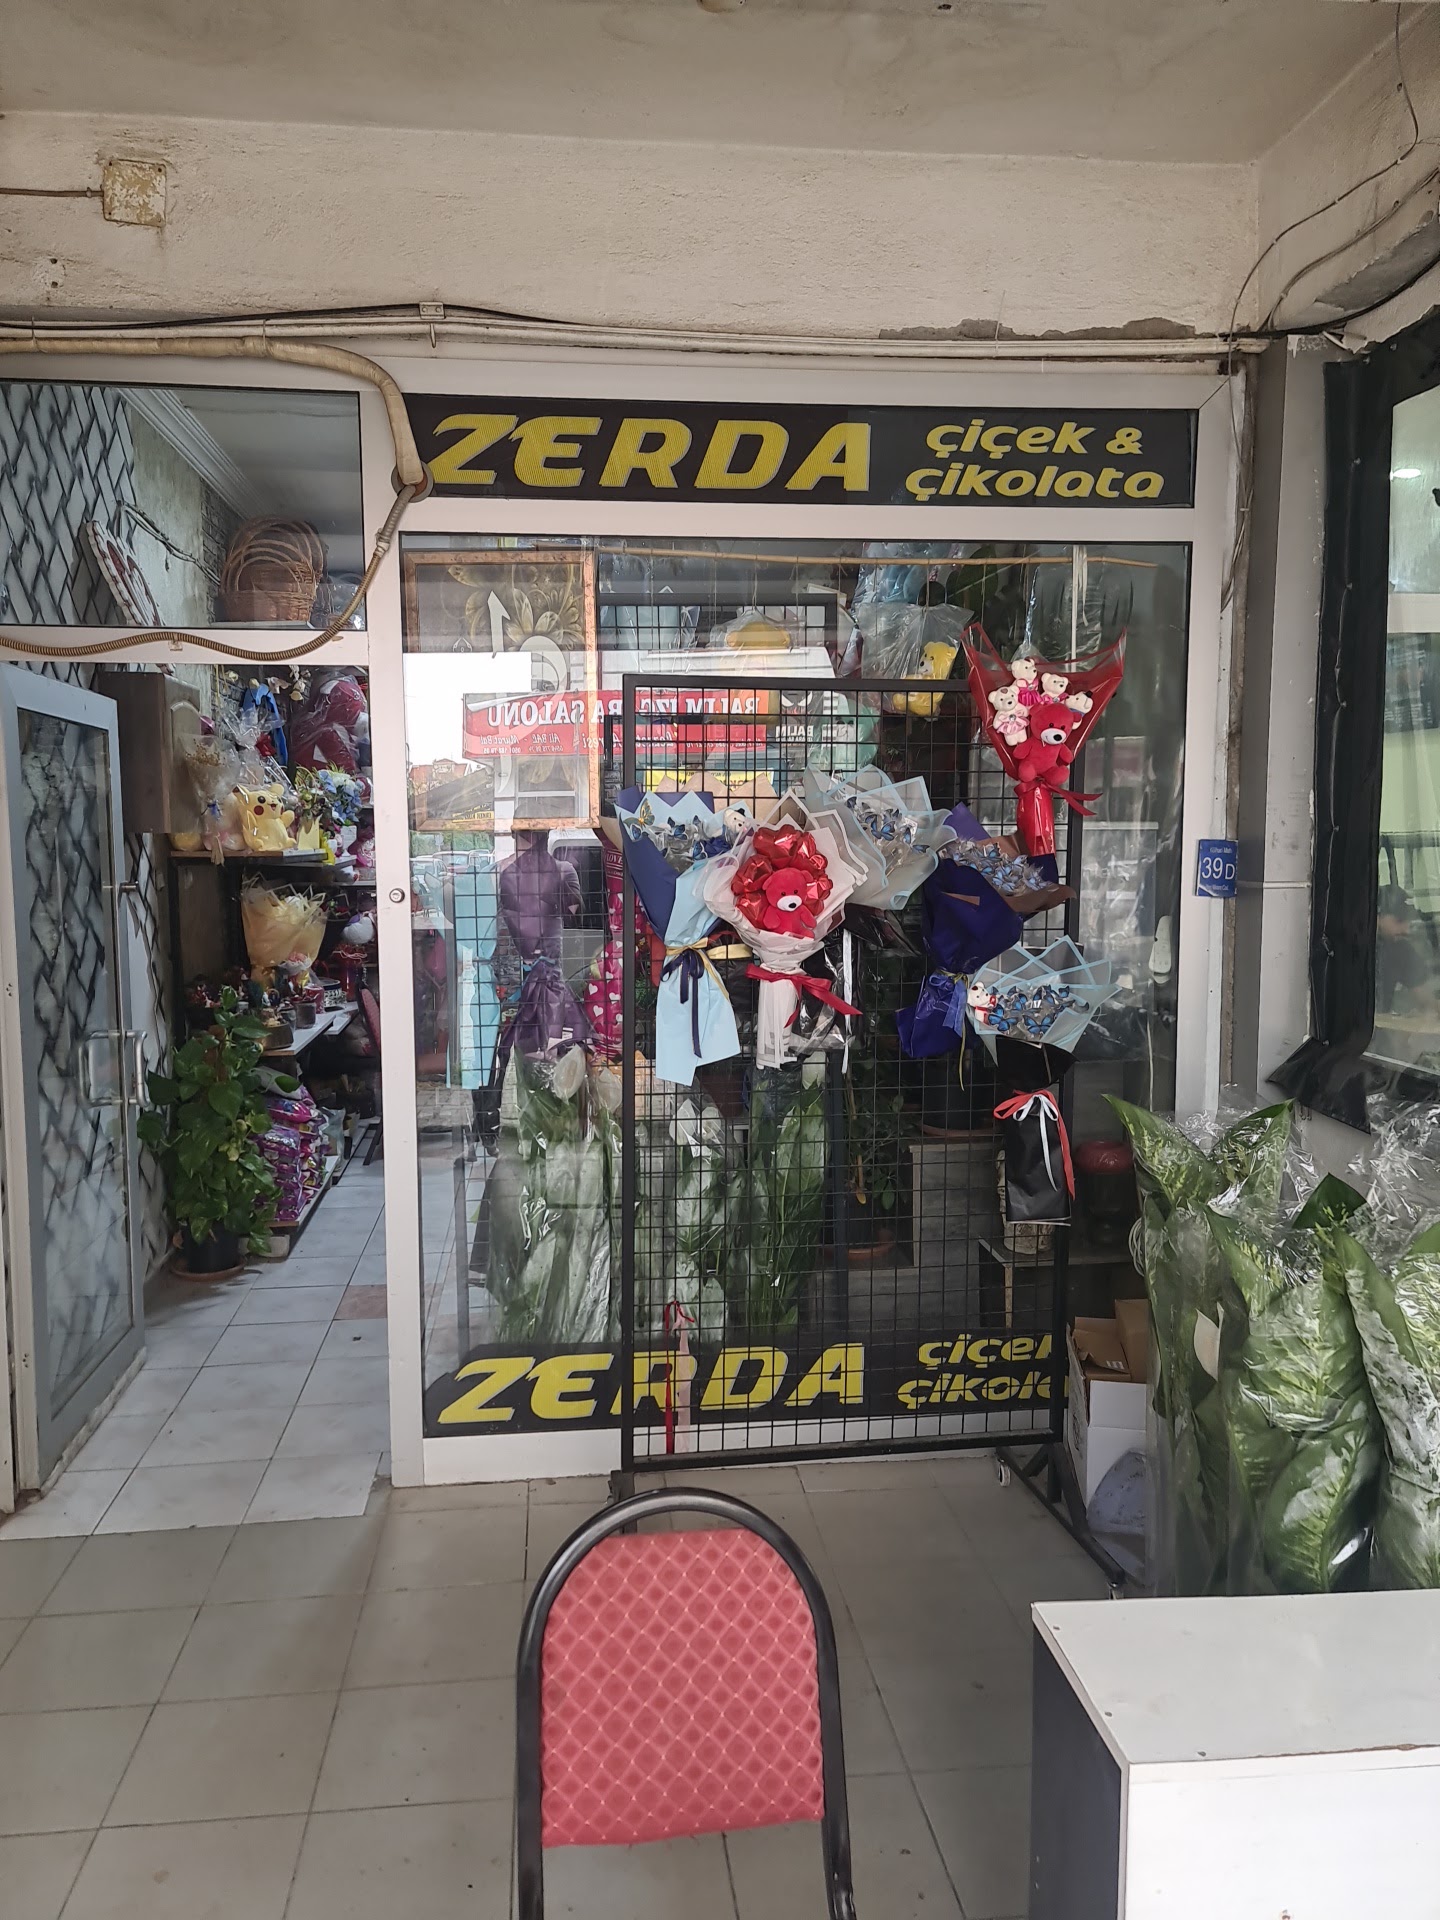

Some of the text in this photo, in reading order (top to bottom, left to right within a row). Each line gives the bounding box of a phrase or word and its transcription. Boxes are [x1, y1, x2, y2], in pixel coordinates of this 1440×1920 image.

[428, 413, 871, 492] ZERDA
[926, 419, 1144, 459] çiçek &
[905, 462, 1165, 501] çikolata
[437, 1343, 865, 1425] ZERDA
